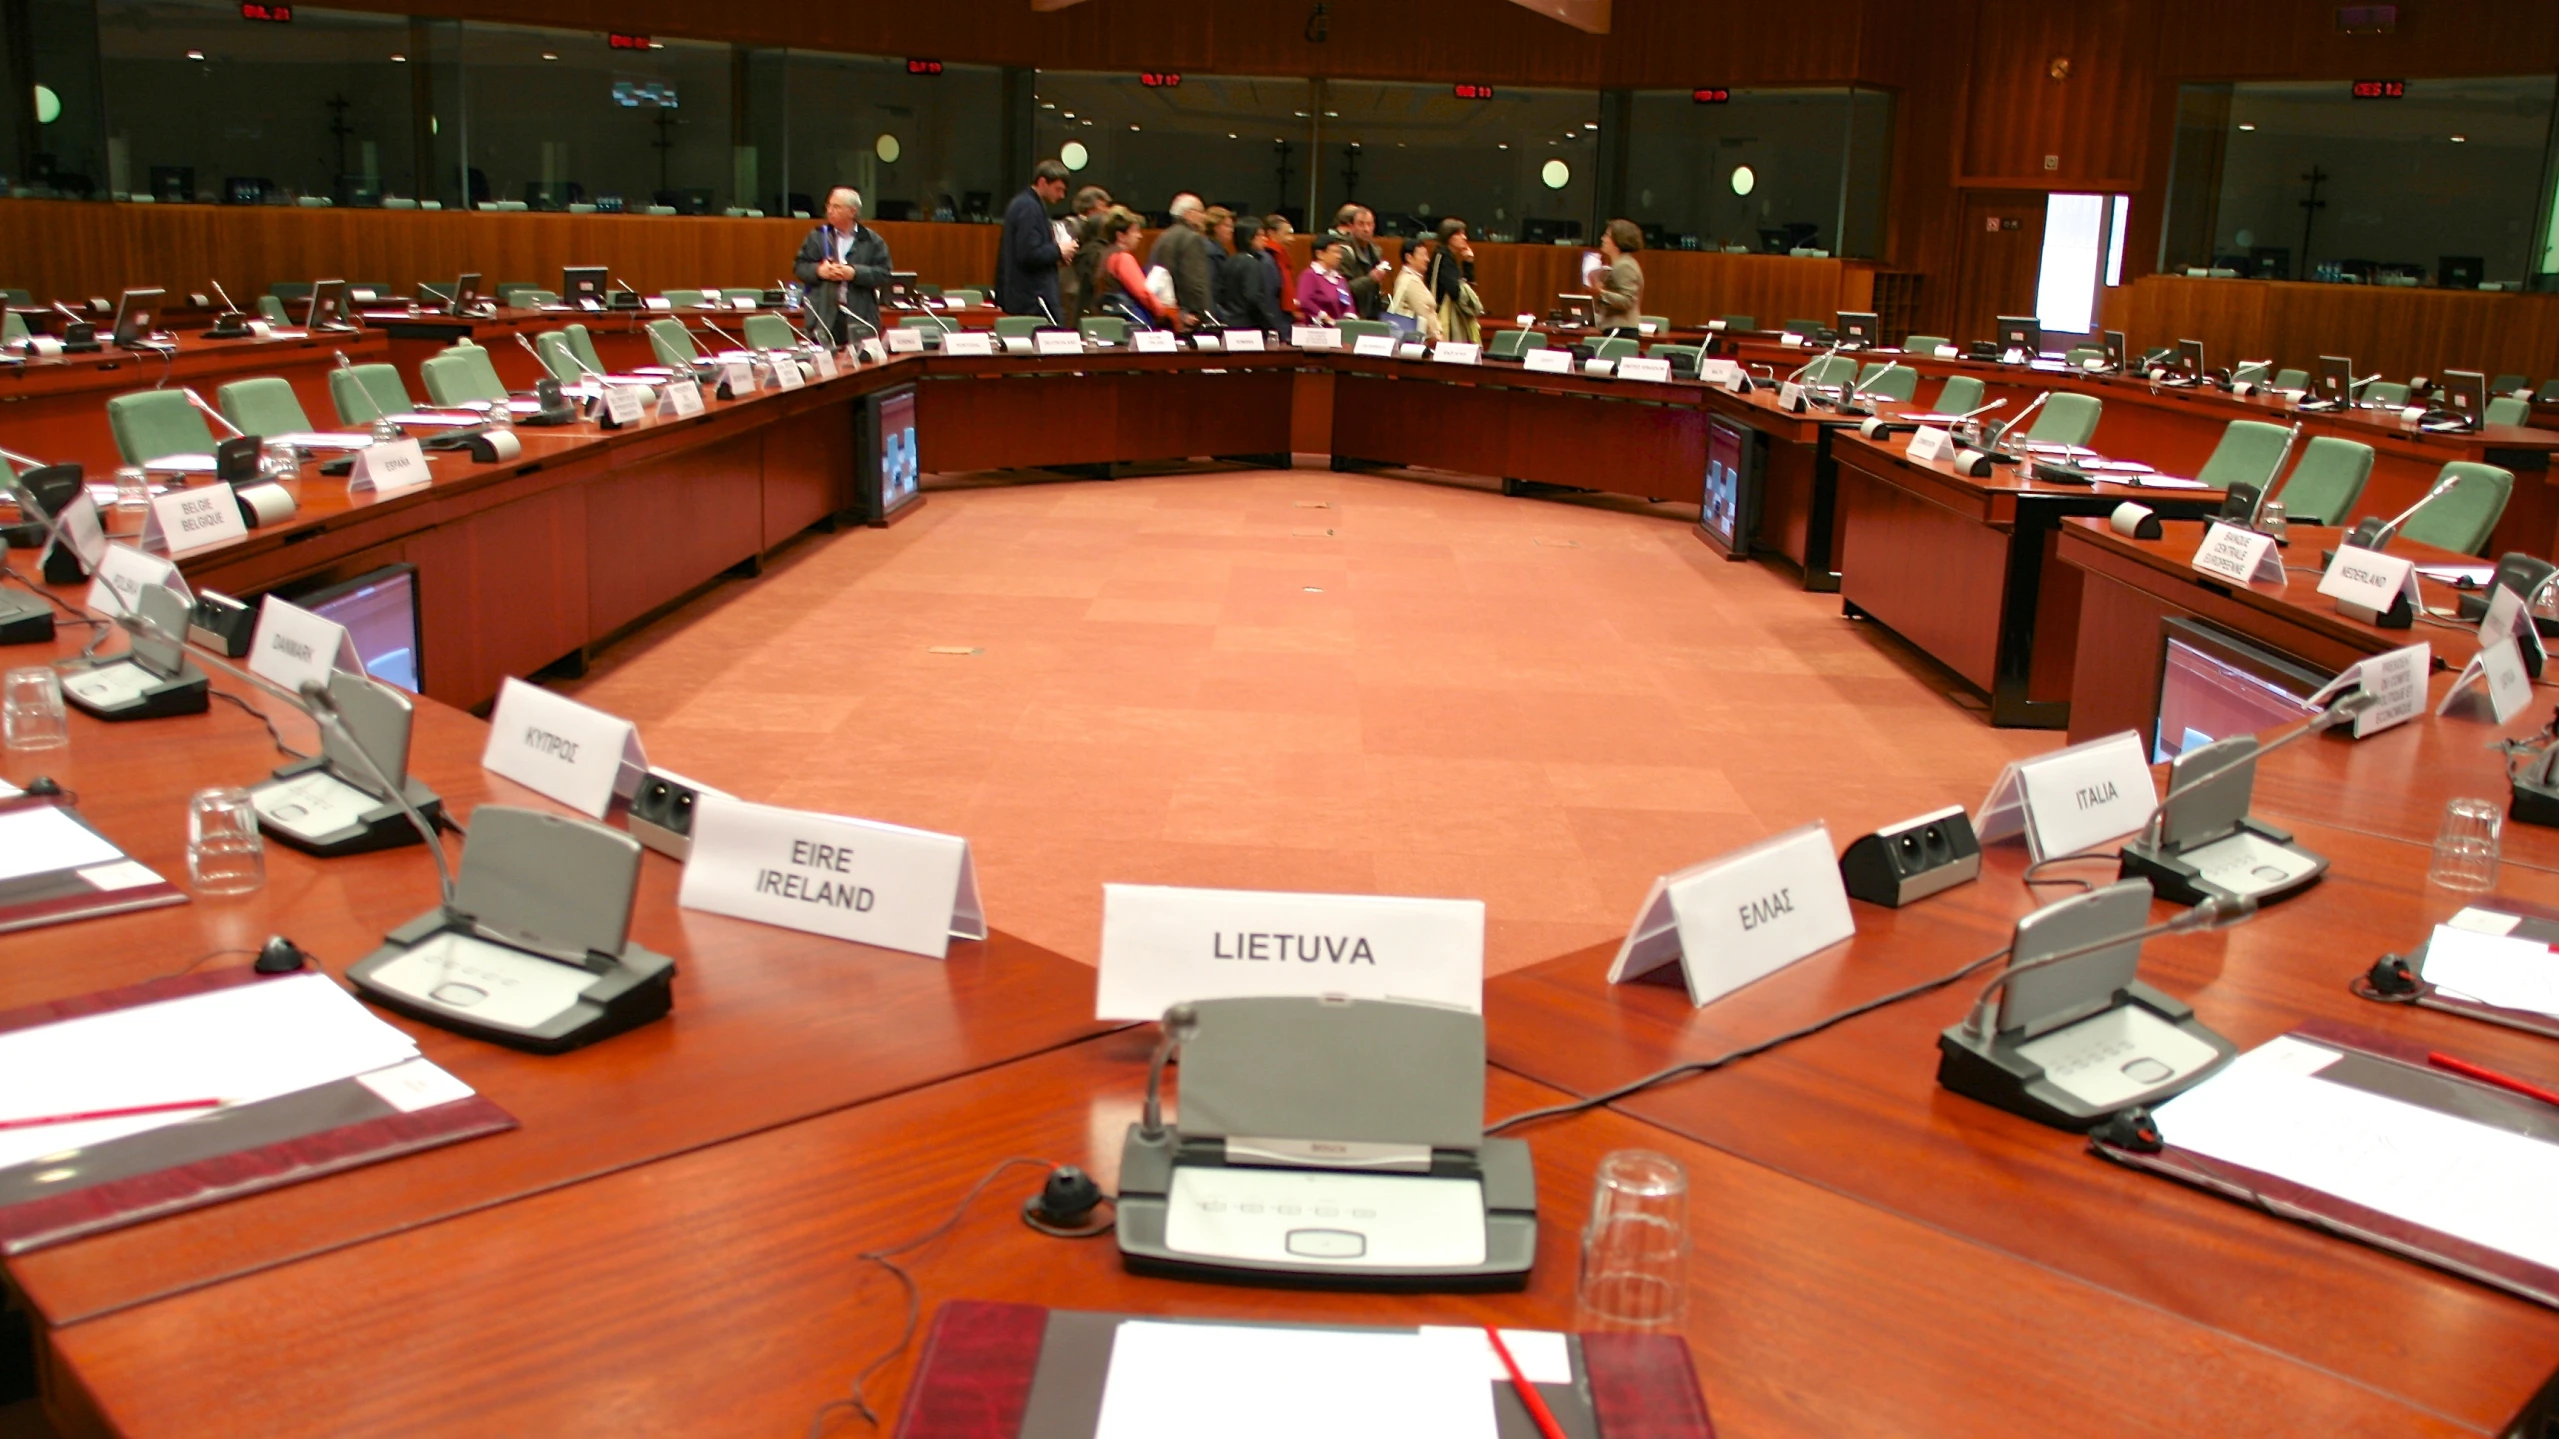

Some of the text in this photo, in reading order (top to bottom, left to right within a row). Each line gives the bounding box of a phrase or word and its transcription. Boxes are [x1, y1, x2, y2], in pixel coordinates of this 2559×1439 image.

[181, 511, 225, 532] BELGIQUE
[2341, 565, 2387, 588] NEDERLAND
[272, 633, 316, 664] DANMARK
[525, 725, 580, 764] ΚΥΠΡΟΣ
[2075, 781, 2119, 811] ITALIA
[791, 839, 854, 874] EIRE
[756, 868, 875, 913] IRELAND
[1739, 888, 1795, 931] ΕΛΛΑΣ
[1213, 931, 1376, 966] LIETUVA
